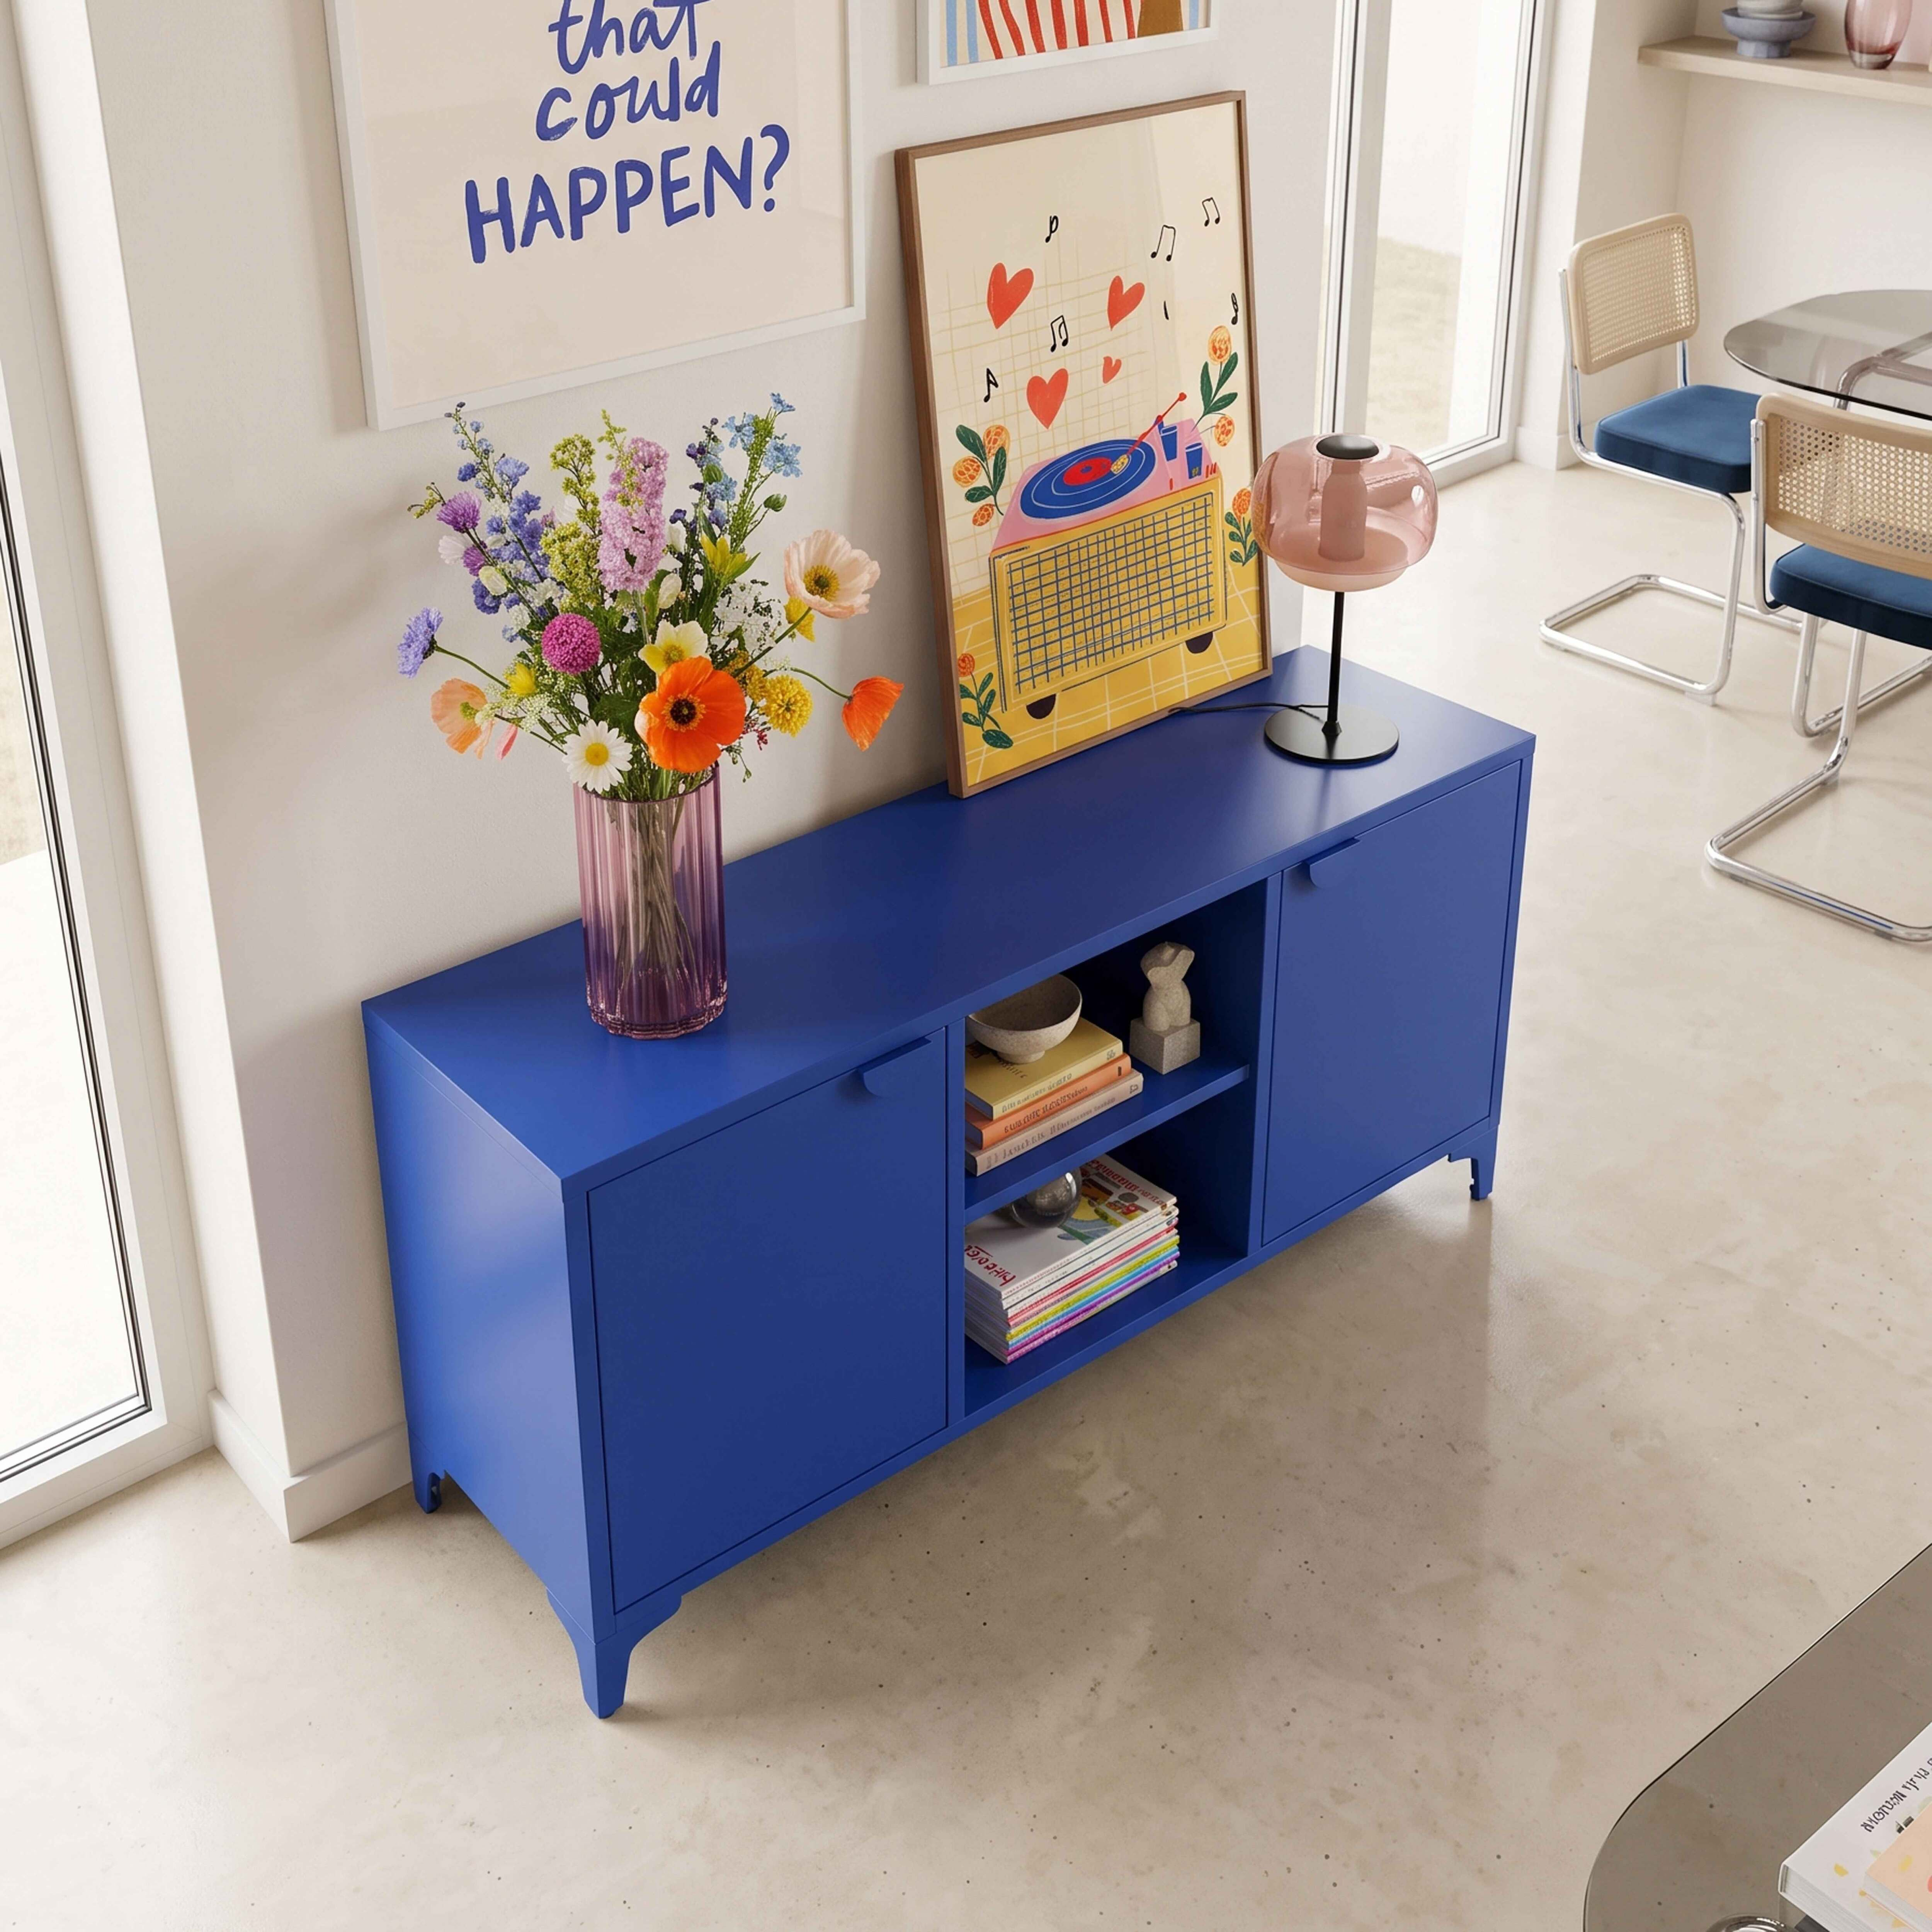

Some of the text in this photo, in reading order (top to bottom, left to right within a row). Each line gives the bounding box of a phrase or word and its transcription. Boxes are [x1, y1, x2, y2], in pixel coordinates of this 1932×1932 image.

[548, 0, 711, 74] that
[536, 41, 720, 141] could
[465, 124, 789, 263] HAPPEN?
